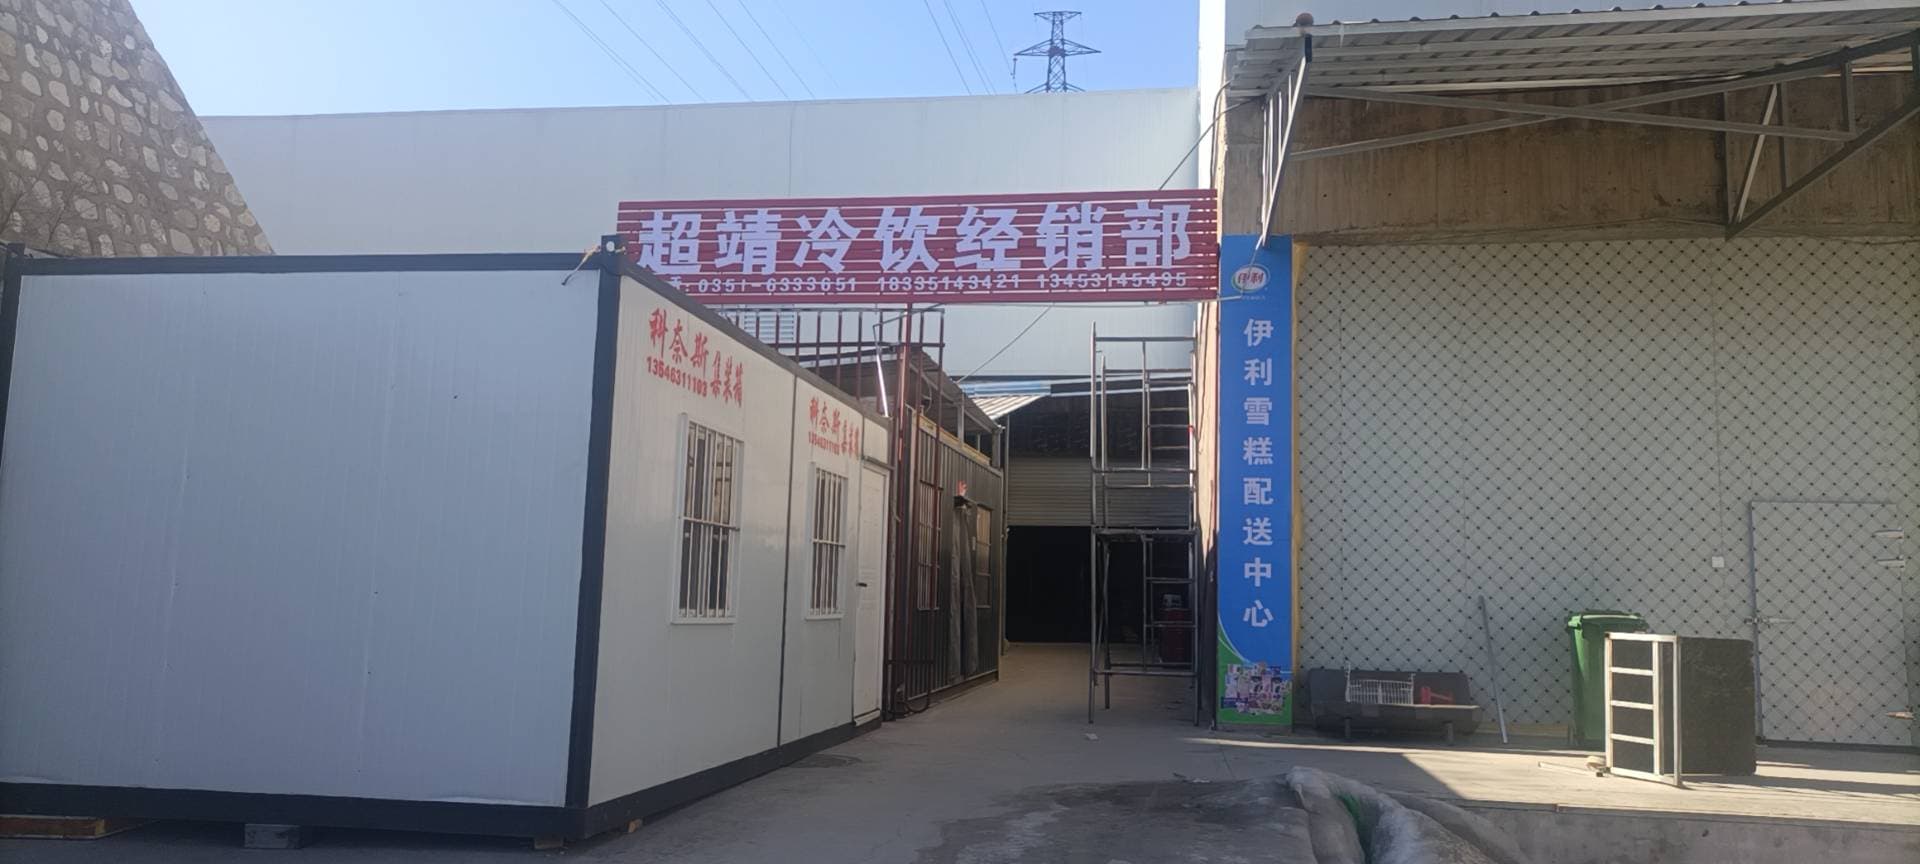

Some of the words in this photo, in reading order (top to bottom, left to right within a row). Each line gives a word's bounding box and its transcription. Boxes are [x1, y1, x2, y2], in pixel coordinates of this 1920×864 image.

[637, 200, 1191, 275] 超靖冷饮经销部
[878, 274, 1020, 292] 18335143421
[1038, 272, 1187, 288] 13453145495
[648, 307, 709, 377] 科奈斯
[1243, 319, 1273, 627] 伊利雪糕配送中心
